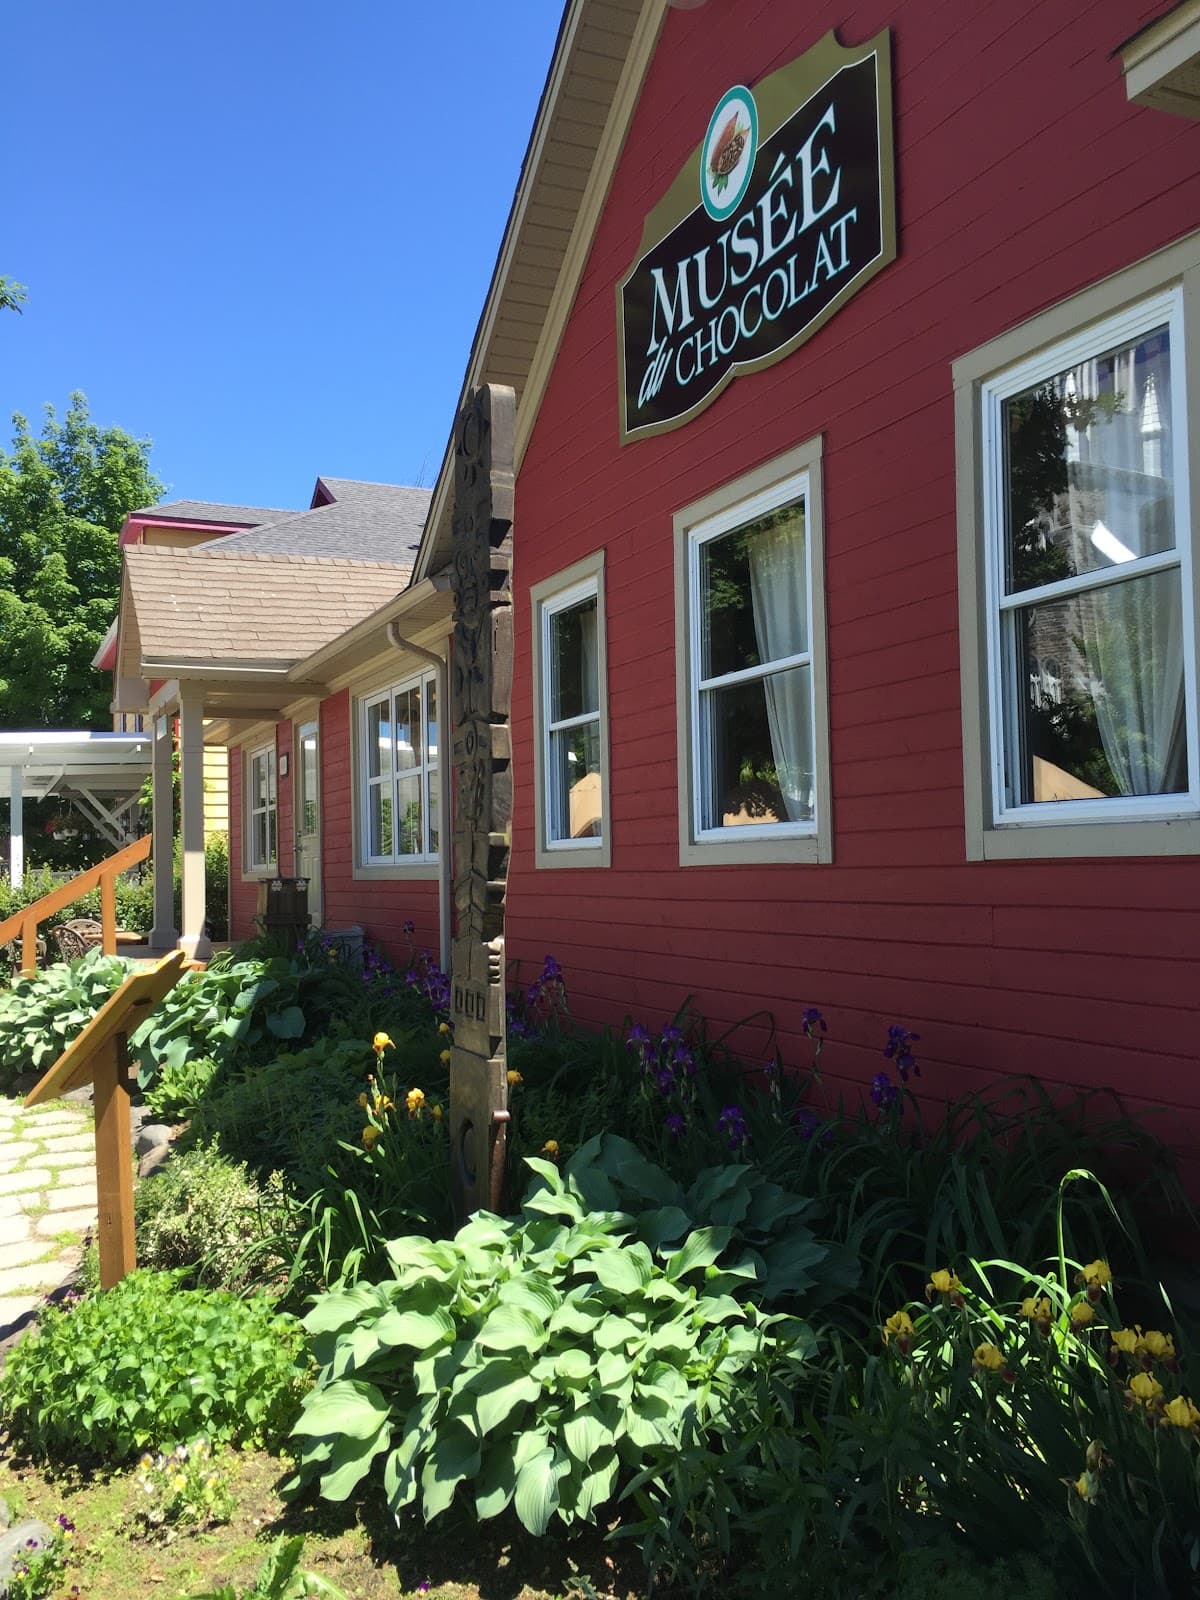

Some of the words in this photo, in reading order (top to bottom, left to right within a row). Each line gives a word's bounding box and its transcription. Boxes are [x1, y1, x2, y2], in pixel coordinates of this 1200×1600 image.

[638, 336, 673, 409] du
[675, 209, 857, 386] CHOCOLAT
[646, 103, 840, 356] MUSÉE
